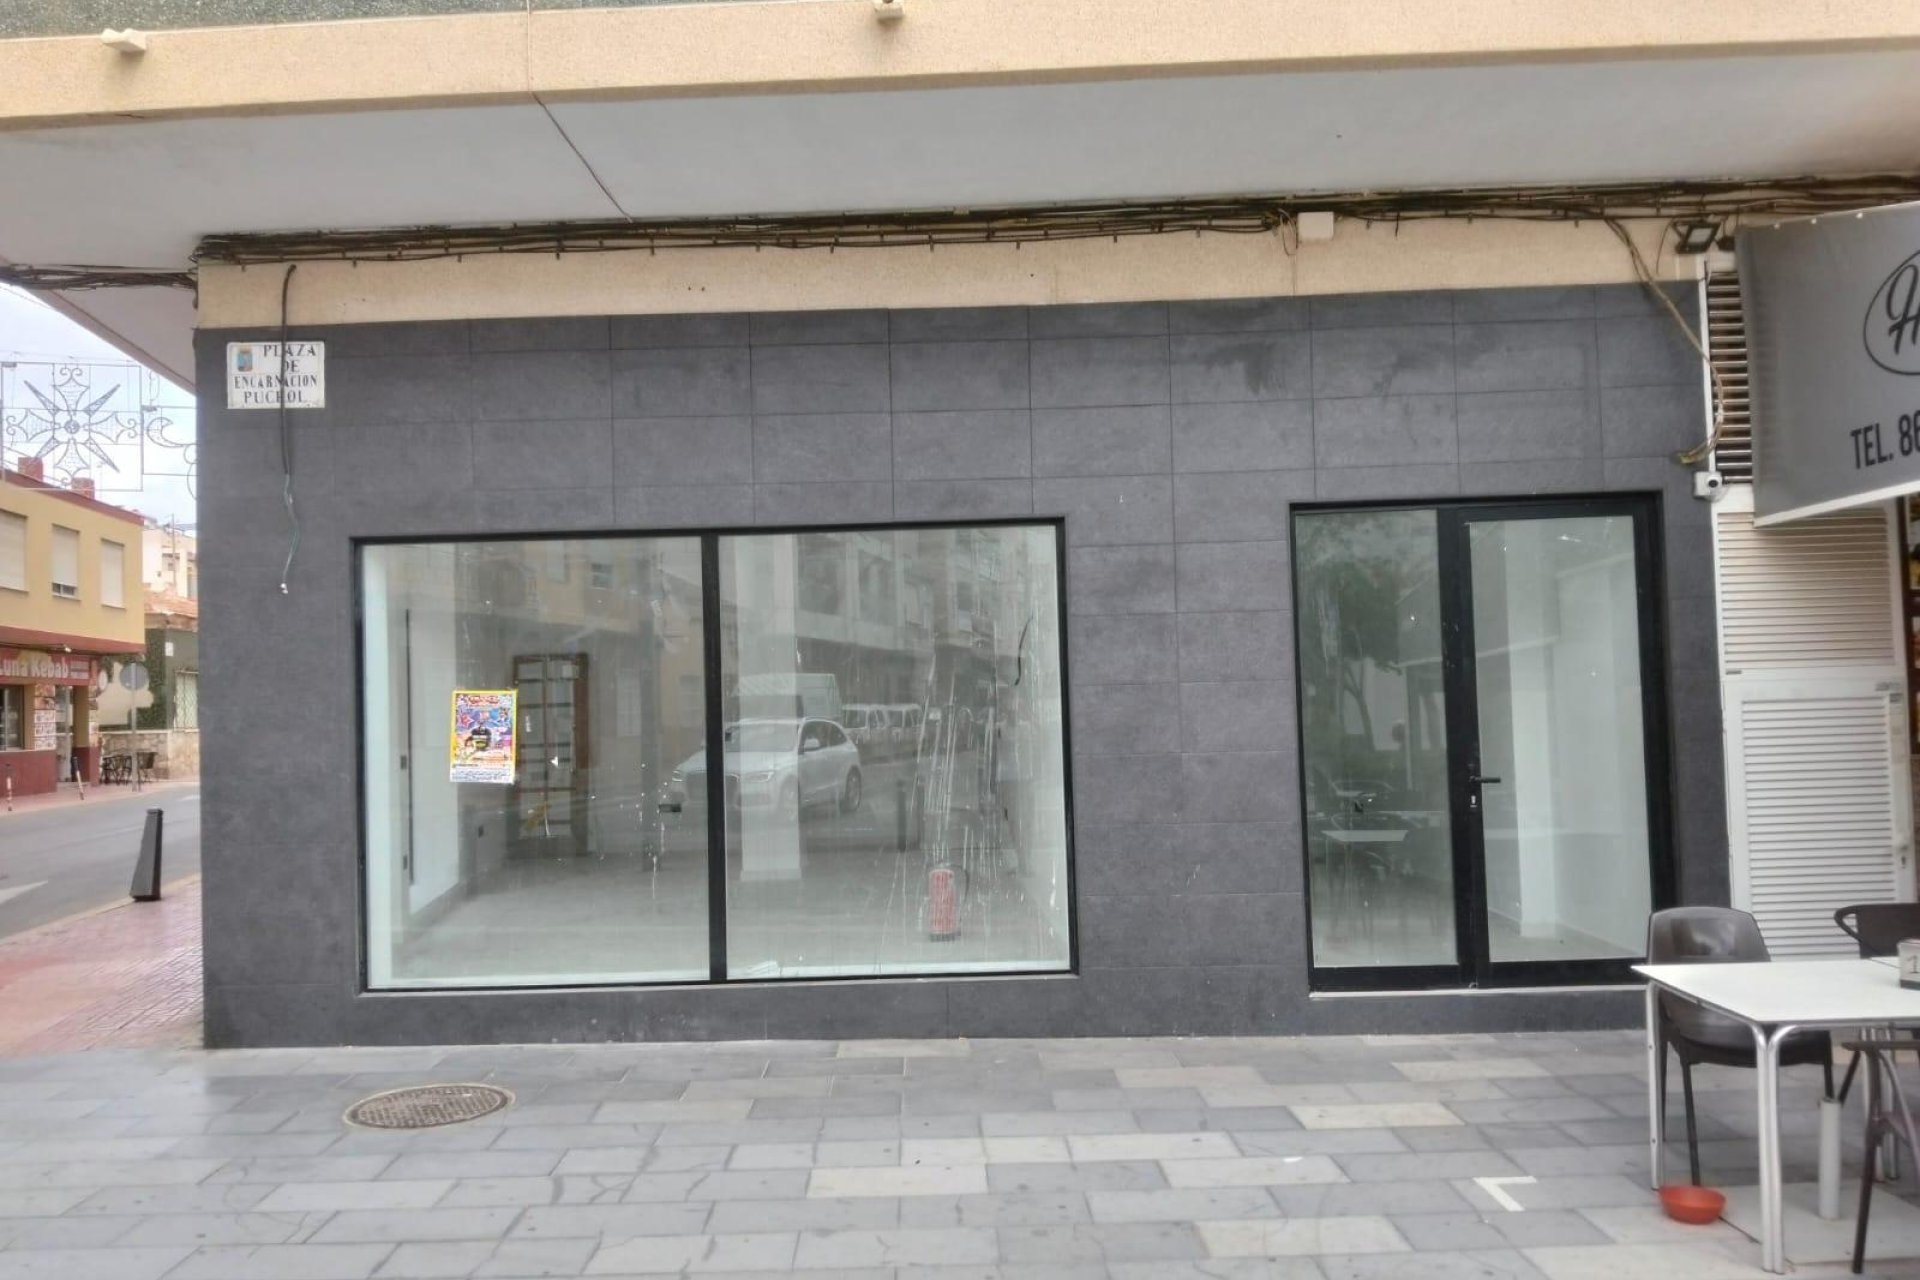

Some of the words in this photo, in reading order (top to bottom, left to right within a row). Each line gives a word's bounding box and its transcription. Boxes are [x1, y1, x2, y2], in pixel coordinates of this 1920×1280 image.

[263, 344, 316, 357] PLAZA
[244, 390, 304, 404] PUCHOL
[1850, 422, 1894, 469] TEL.
[0, 658, 29, 677] una
[31, 655, 69, 679] Kebab
